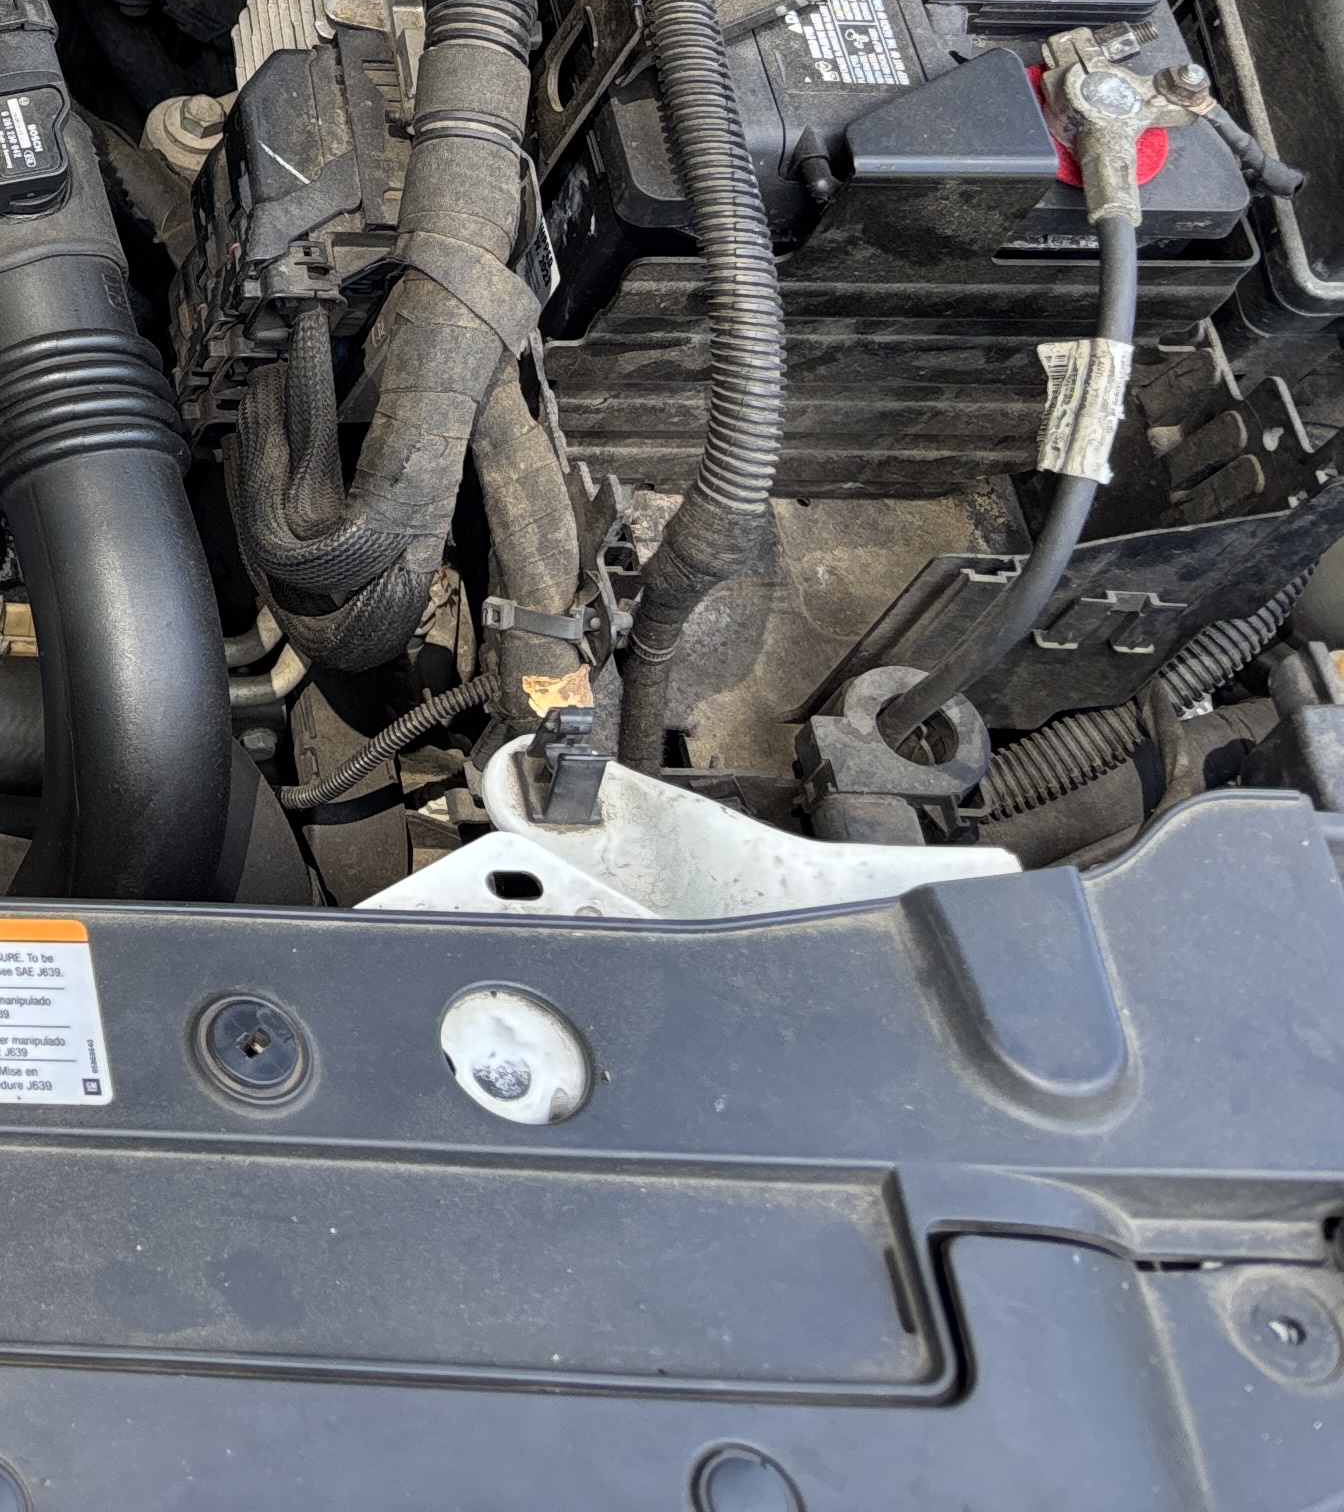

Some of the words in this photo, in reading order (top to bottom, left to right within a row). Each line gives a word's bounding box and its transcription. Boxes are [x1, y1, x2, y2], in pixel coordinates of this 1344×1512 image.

[27, 123, 44, 152] BOSCH
[27, 953, 38, 962] To
[40, 954, 54, 963] be
[14, 966, 34, 976] SAE
[24, 1068, 38, 1076] en
